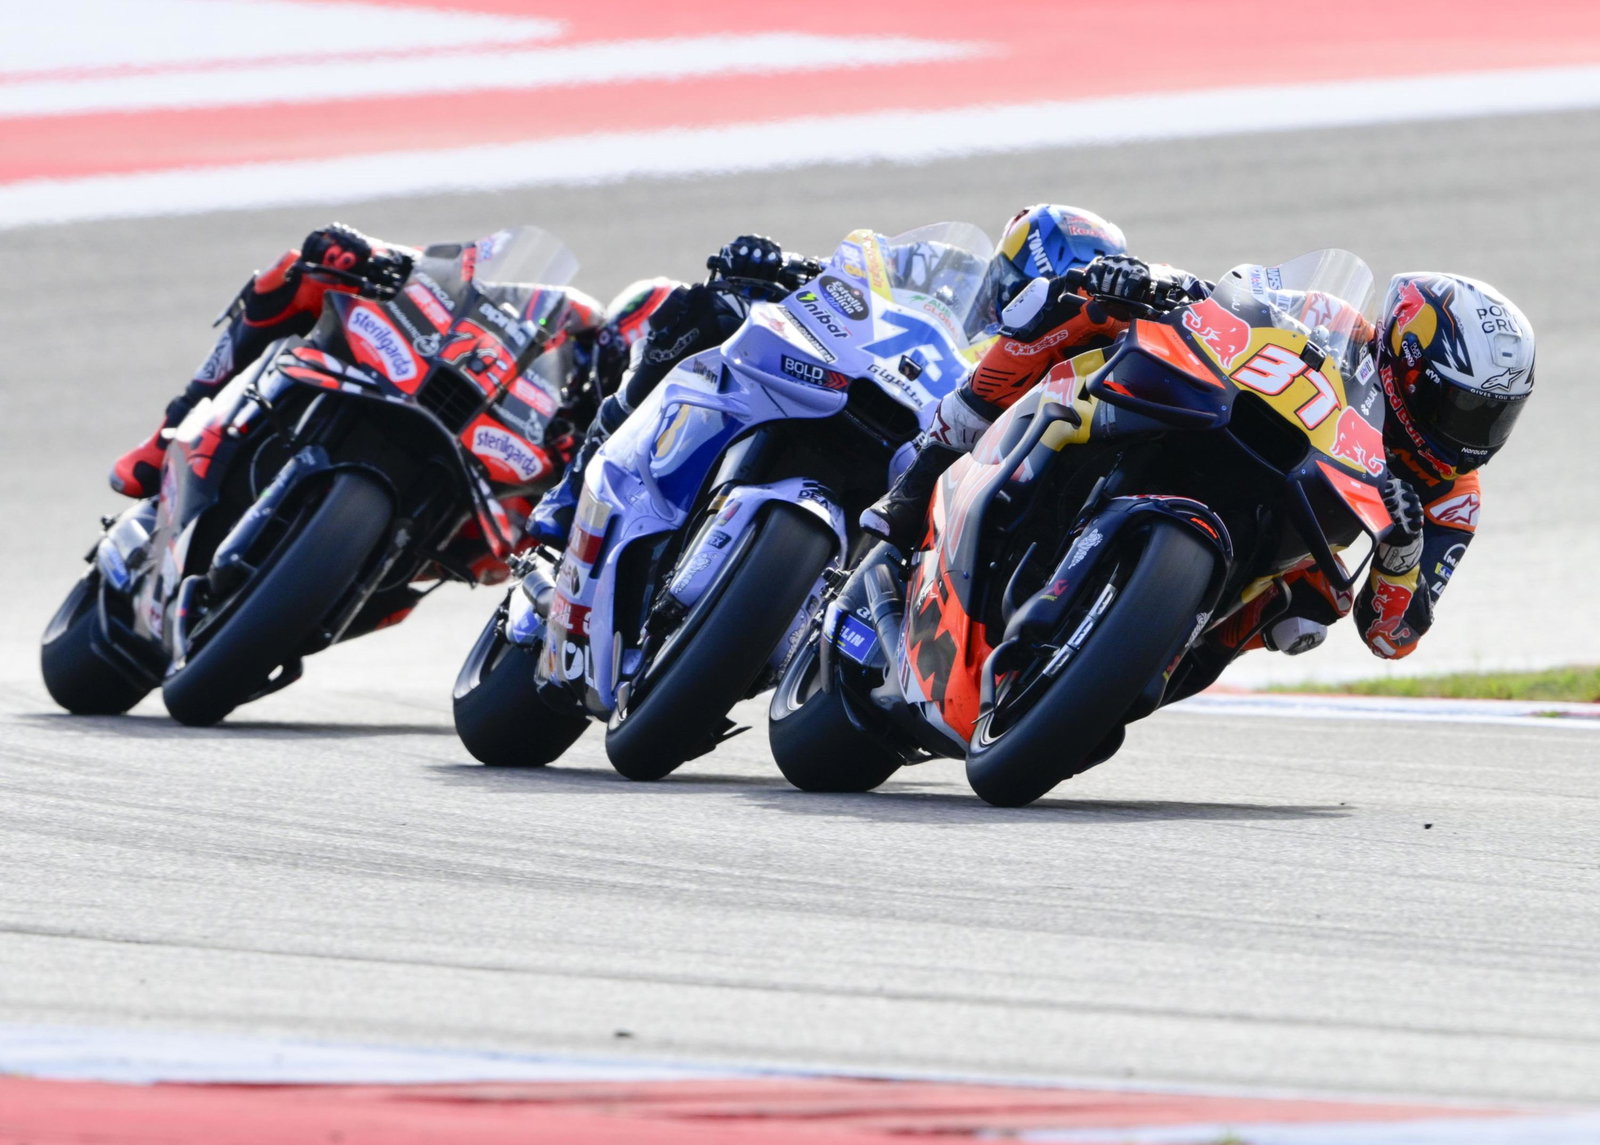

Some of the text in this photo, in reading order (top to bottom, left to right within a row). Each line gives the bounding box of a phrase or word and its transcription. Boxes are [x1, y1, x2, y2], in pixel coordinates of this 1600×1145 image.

[825, 284, 855, 315] Galicia
[831, 280, 864, 312] Estrella
[352, 311, 411, 377] sterilgarda
[784, 357, 824, 380] BOLD
[1229, 342, 1342, 431] 37
[1379, 364, 1426, 448] Red Bull
[1470, 387, 1491, 398] GIVES
[476, 430, 537, 477] sterilgarda
